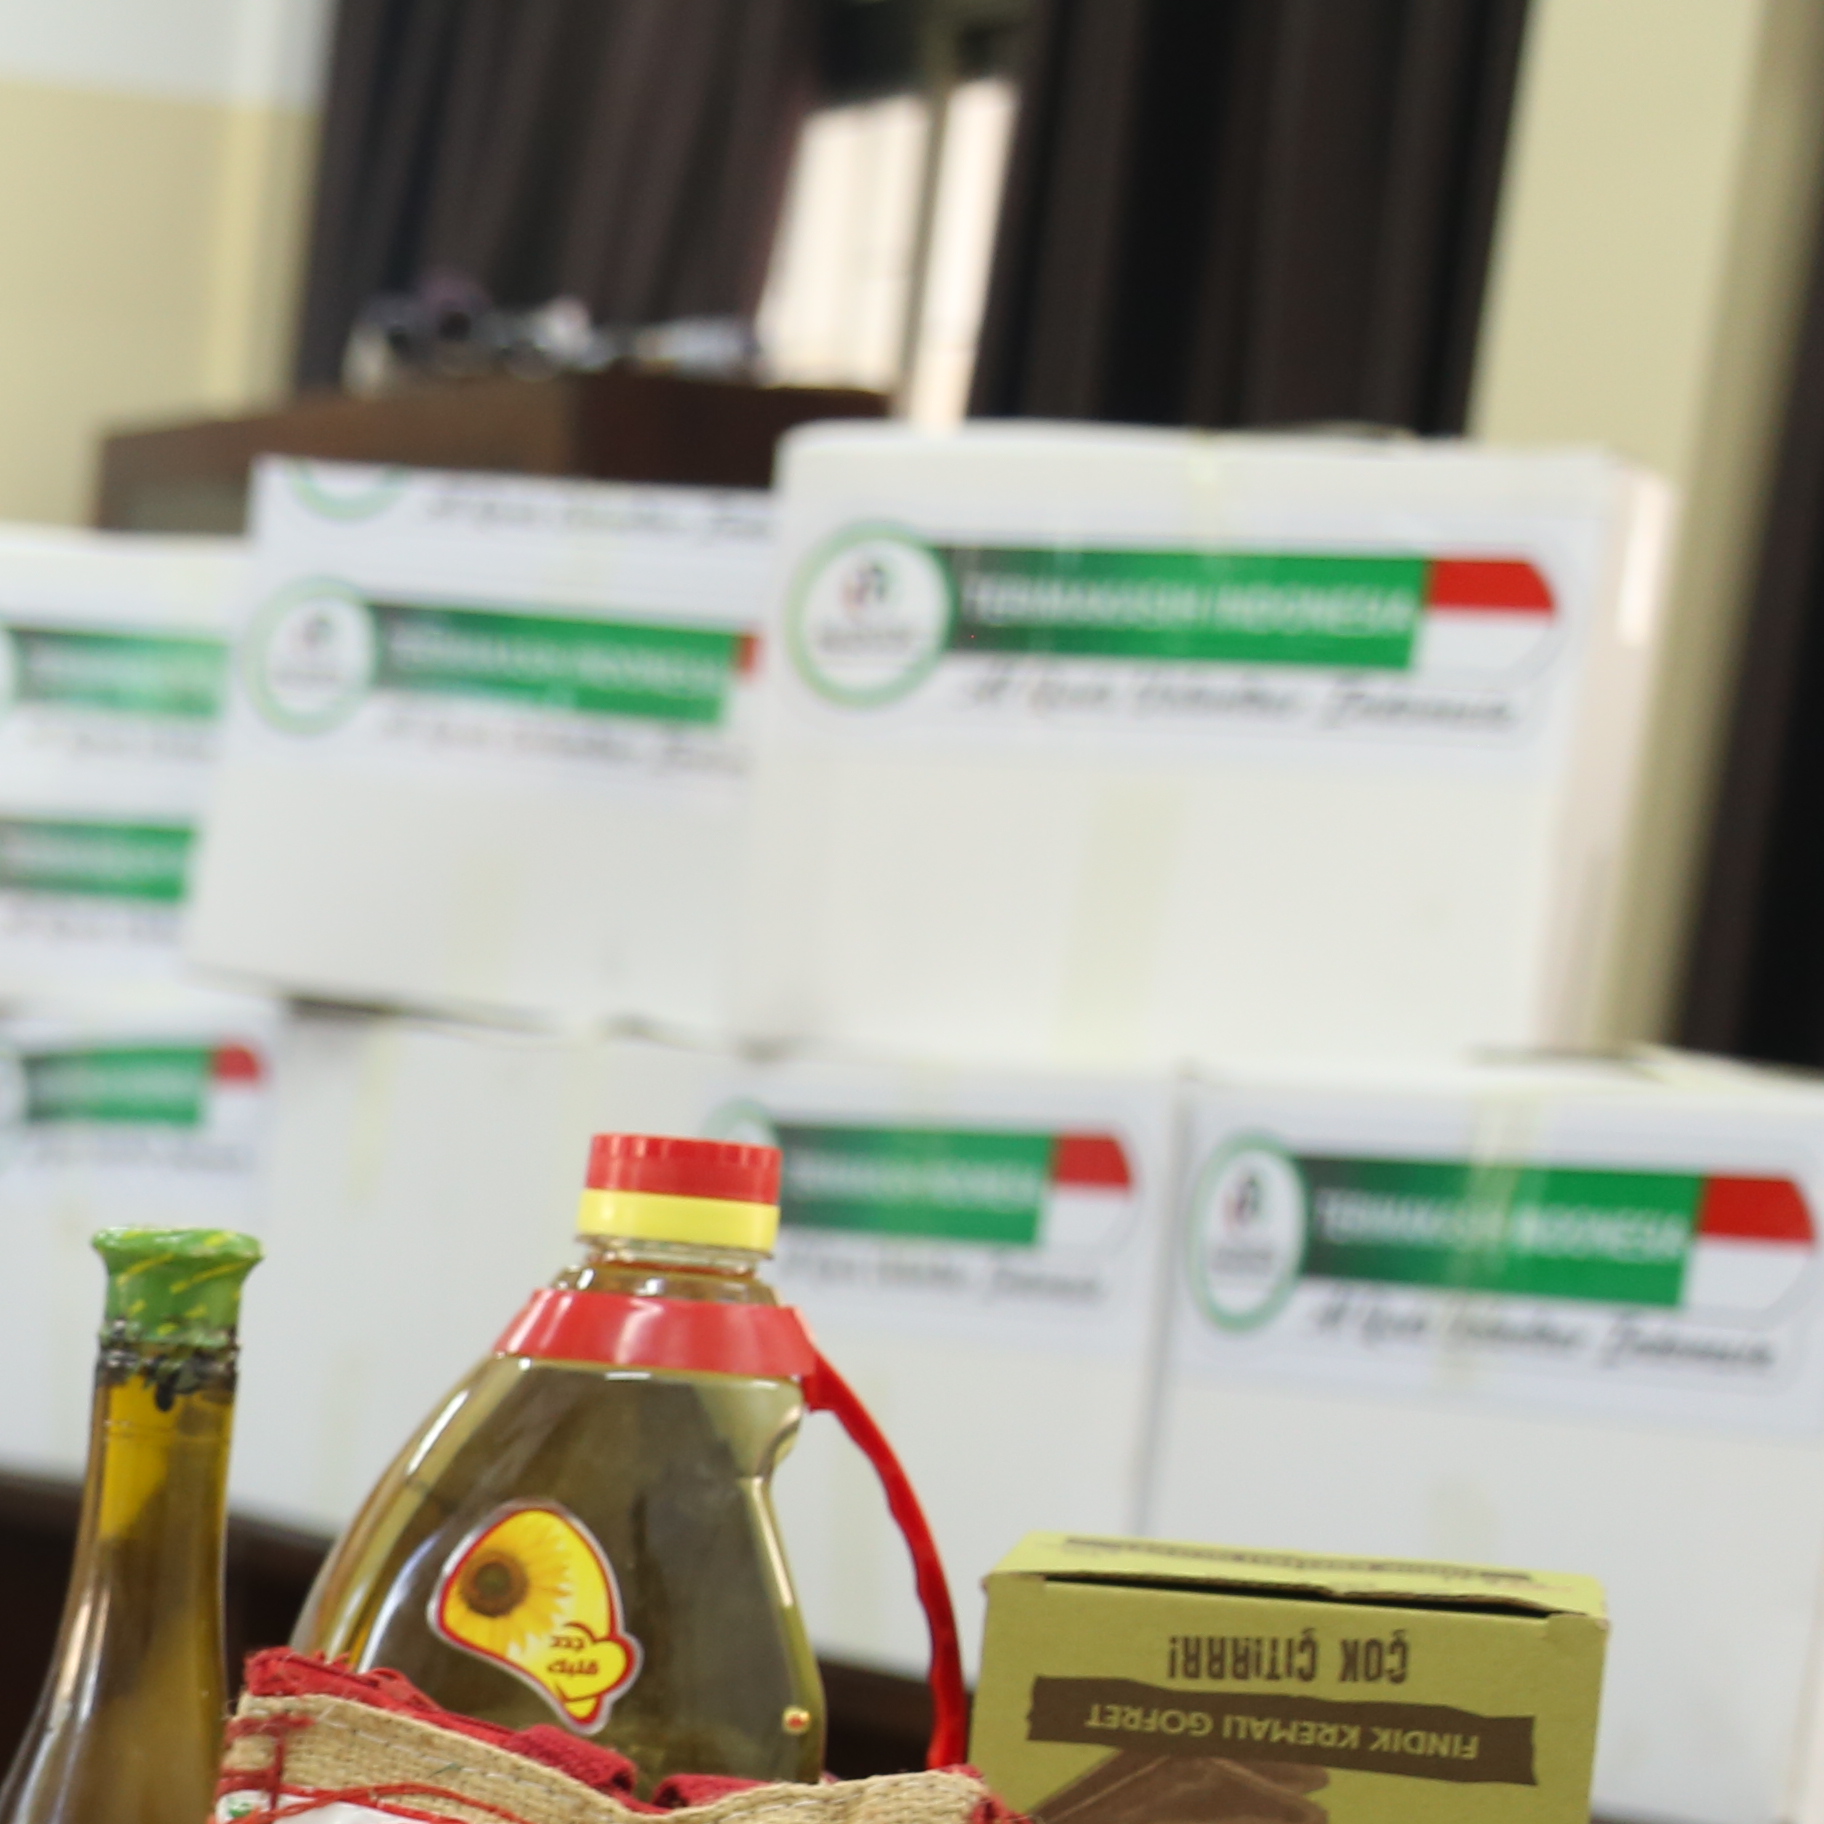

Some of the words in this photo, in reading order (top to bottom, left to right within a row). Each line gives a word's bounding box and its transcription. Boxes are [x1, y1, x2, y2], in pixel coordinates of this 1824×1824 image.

[1338, 1636, 1411, 1686] ÇOK
[1082, 1700, 1214, 1738] GOFRET
[1221, 1712, 1362, 1748] KREMALI
[1368, 1723, 1481, 1761] FINDIK
